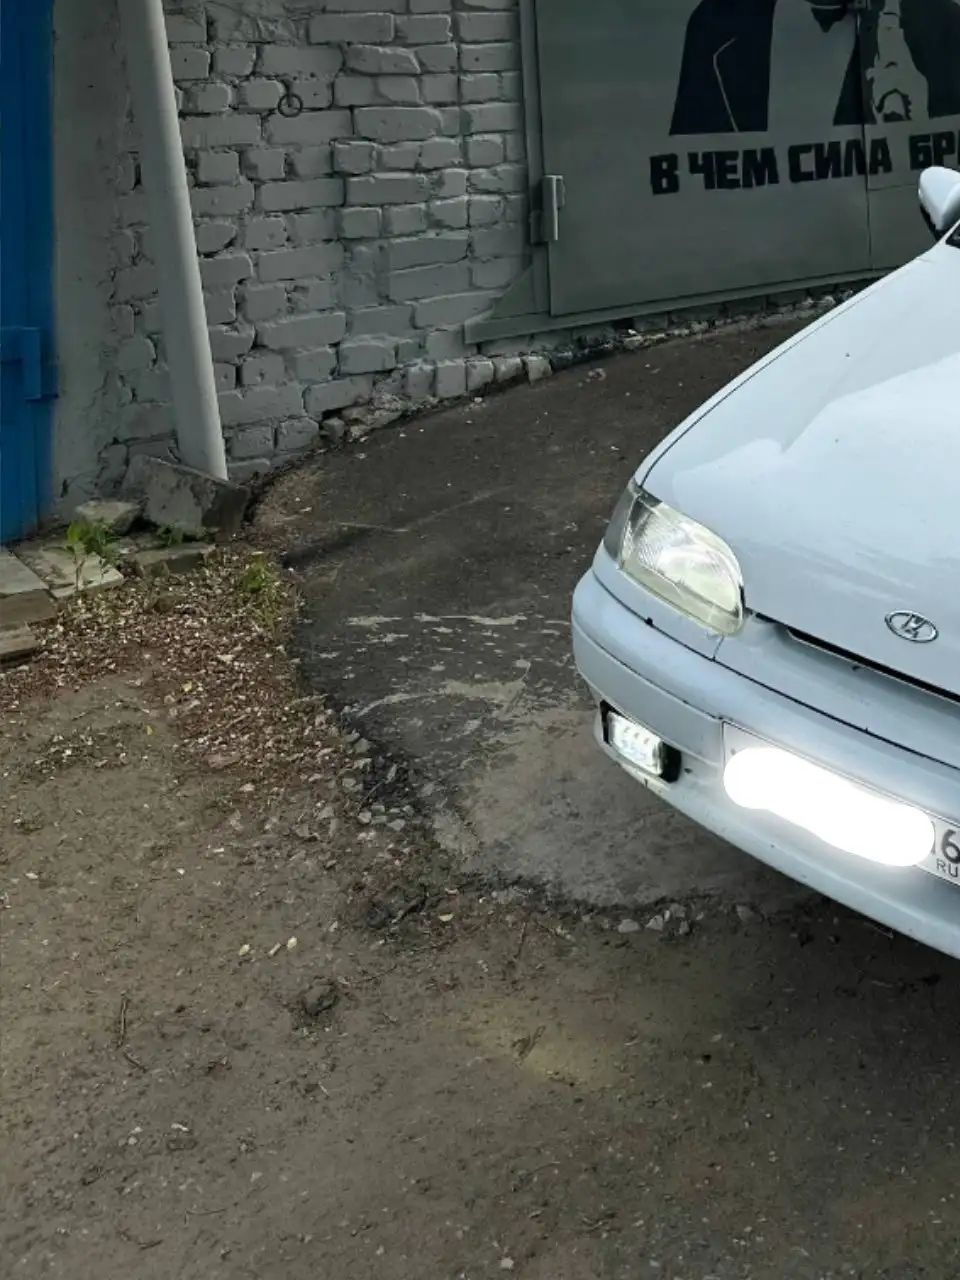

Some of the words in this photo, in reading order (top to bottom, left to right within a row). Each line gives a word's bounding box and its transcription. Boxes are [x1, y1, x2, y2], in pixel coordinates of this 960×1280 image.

[649, 153, 680, 195] В
[688, 147, 780, 190] ЧЕМ
[787, 137, 893, 183] СИЛА
